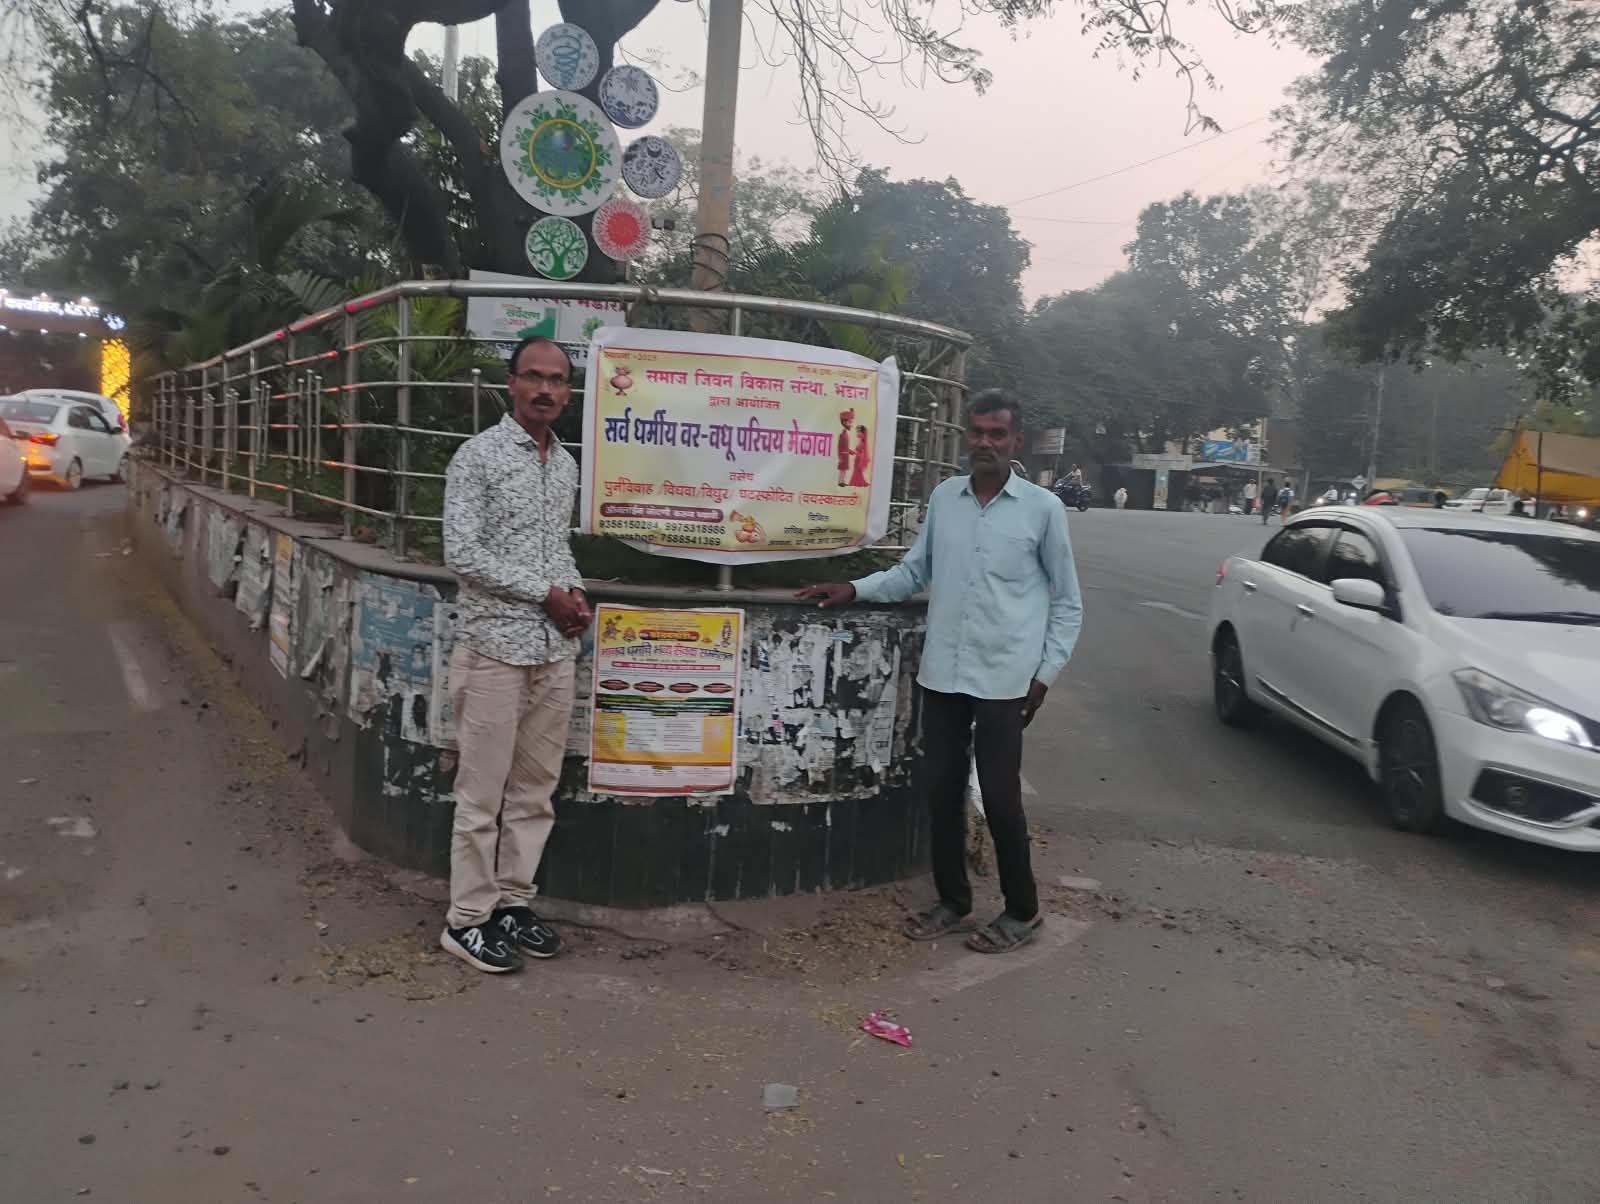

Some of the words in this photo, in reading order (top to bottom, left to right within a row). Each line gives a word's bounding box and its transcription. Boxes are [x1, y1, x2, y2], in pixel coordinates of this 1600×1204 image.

[646, 369, 688, 384] समाज
[694, 368, 733, 388] जिवन
[740, 371, 785, 392] विकास
[604, 407, 632, 443] सर्व
[634, 409, 678, 446] धर्मीय
[737, 416, 784, 453] परिचय
[787, 418, 833, 457] मेळावा
